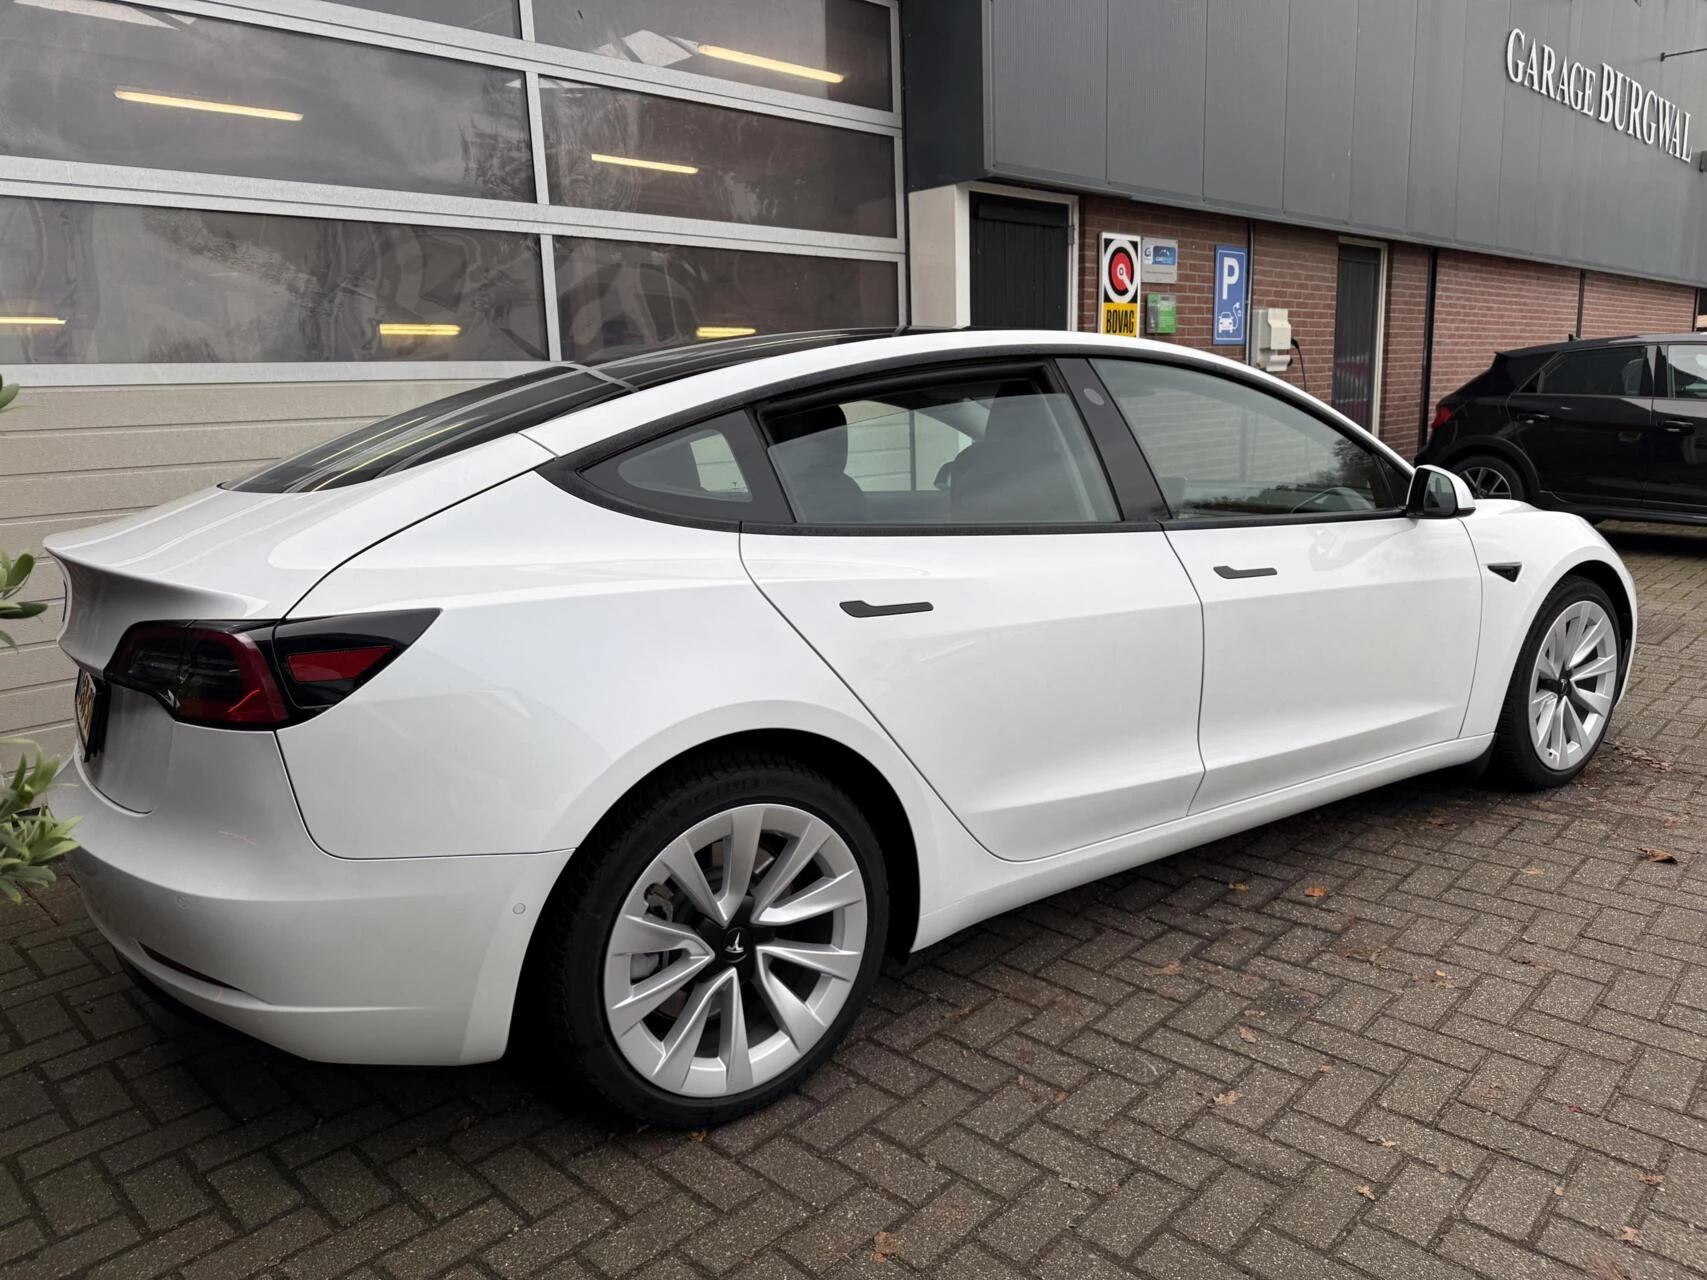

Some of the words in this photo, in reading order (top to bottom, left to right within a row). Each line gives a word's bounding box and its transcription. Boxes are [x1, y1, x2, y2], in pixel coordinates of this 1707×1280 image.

[1506, 27, 1596, 117] GARAGE
[1598, 62, 1693, 163] BURGWAL
[1222, 256, 1240, 300] P
[1106, 309, 1135, 334] BOVAG
